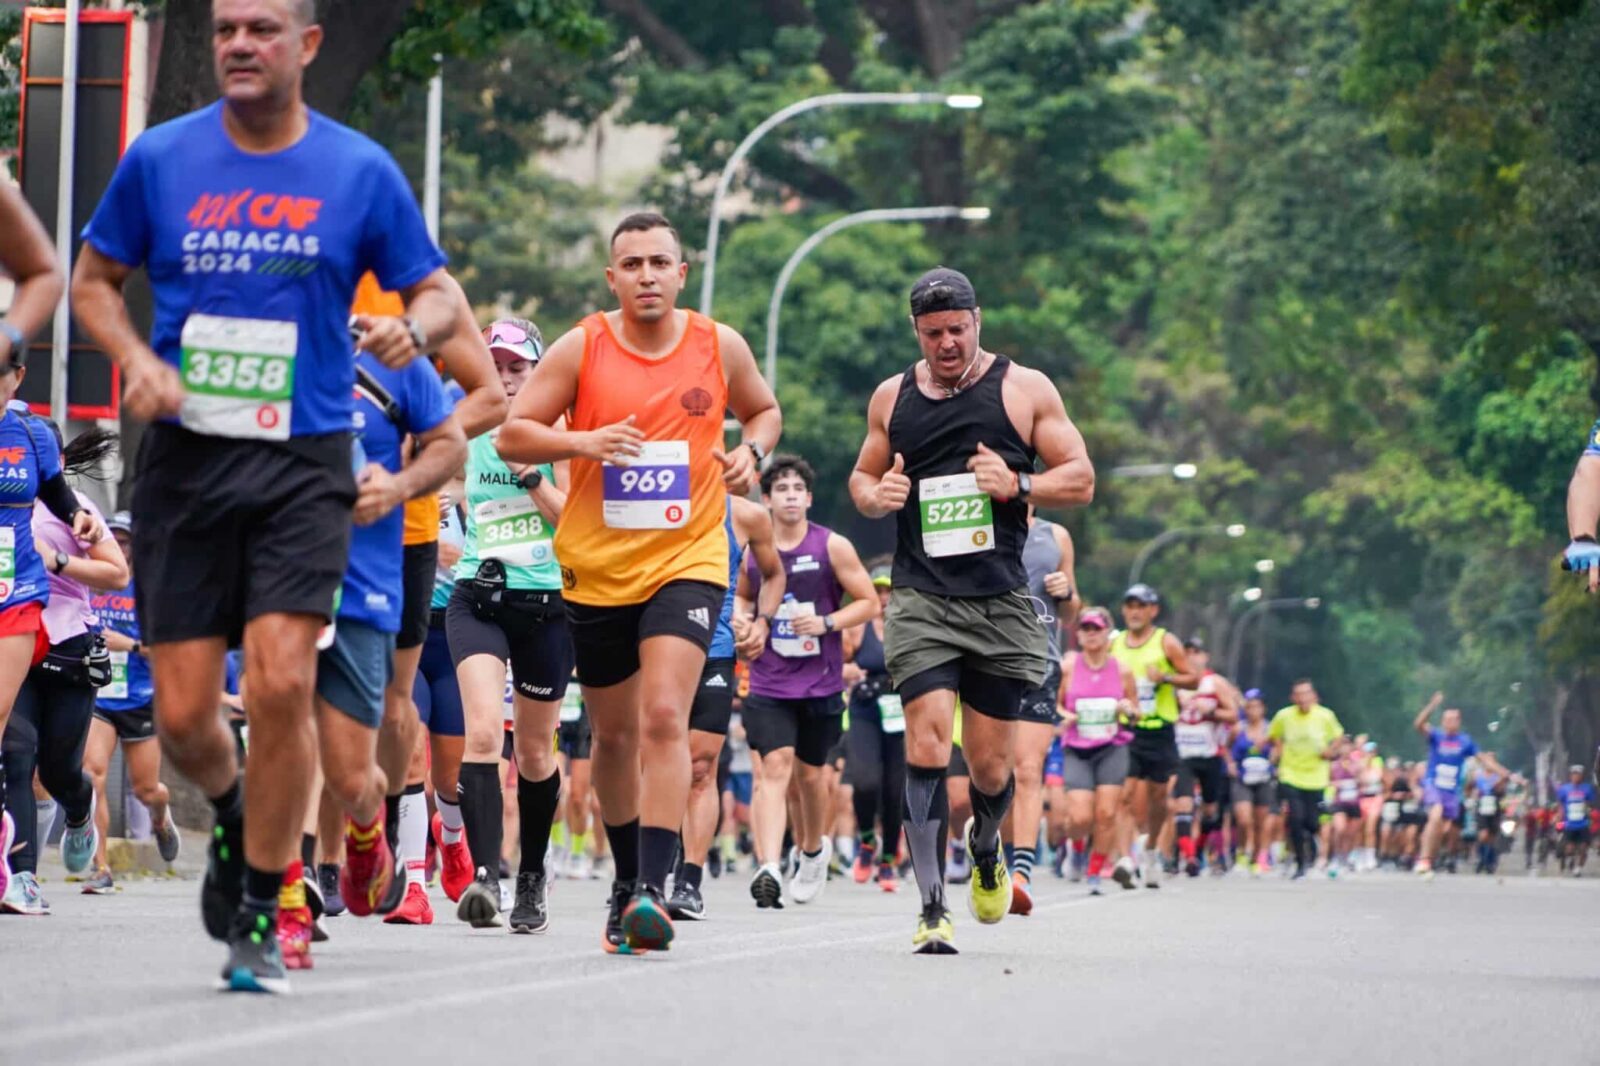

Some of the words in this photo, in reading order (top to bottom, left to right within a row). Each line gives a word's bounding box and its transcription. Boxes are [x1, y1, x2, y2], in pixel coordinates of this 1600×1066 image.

[181, 230, 320, 256] CARACAS
[182, 252, 252, 273] 2024
[185, 351, 289, 391] 3358
[620, 469, 675, 493] 969
[928, 499, 984, 524] 5222
[484, 515, 543, 543] 3838
